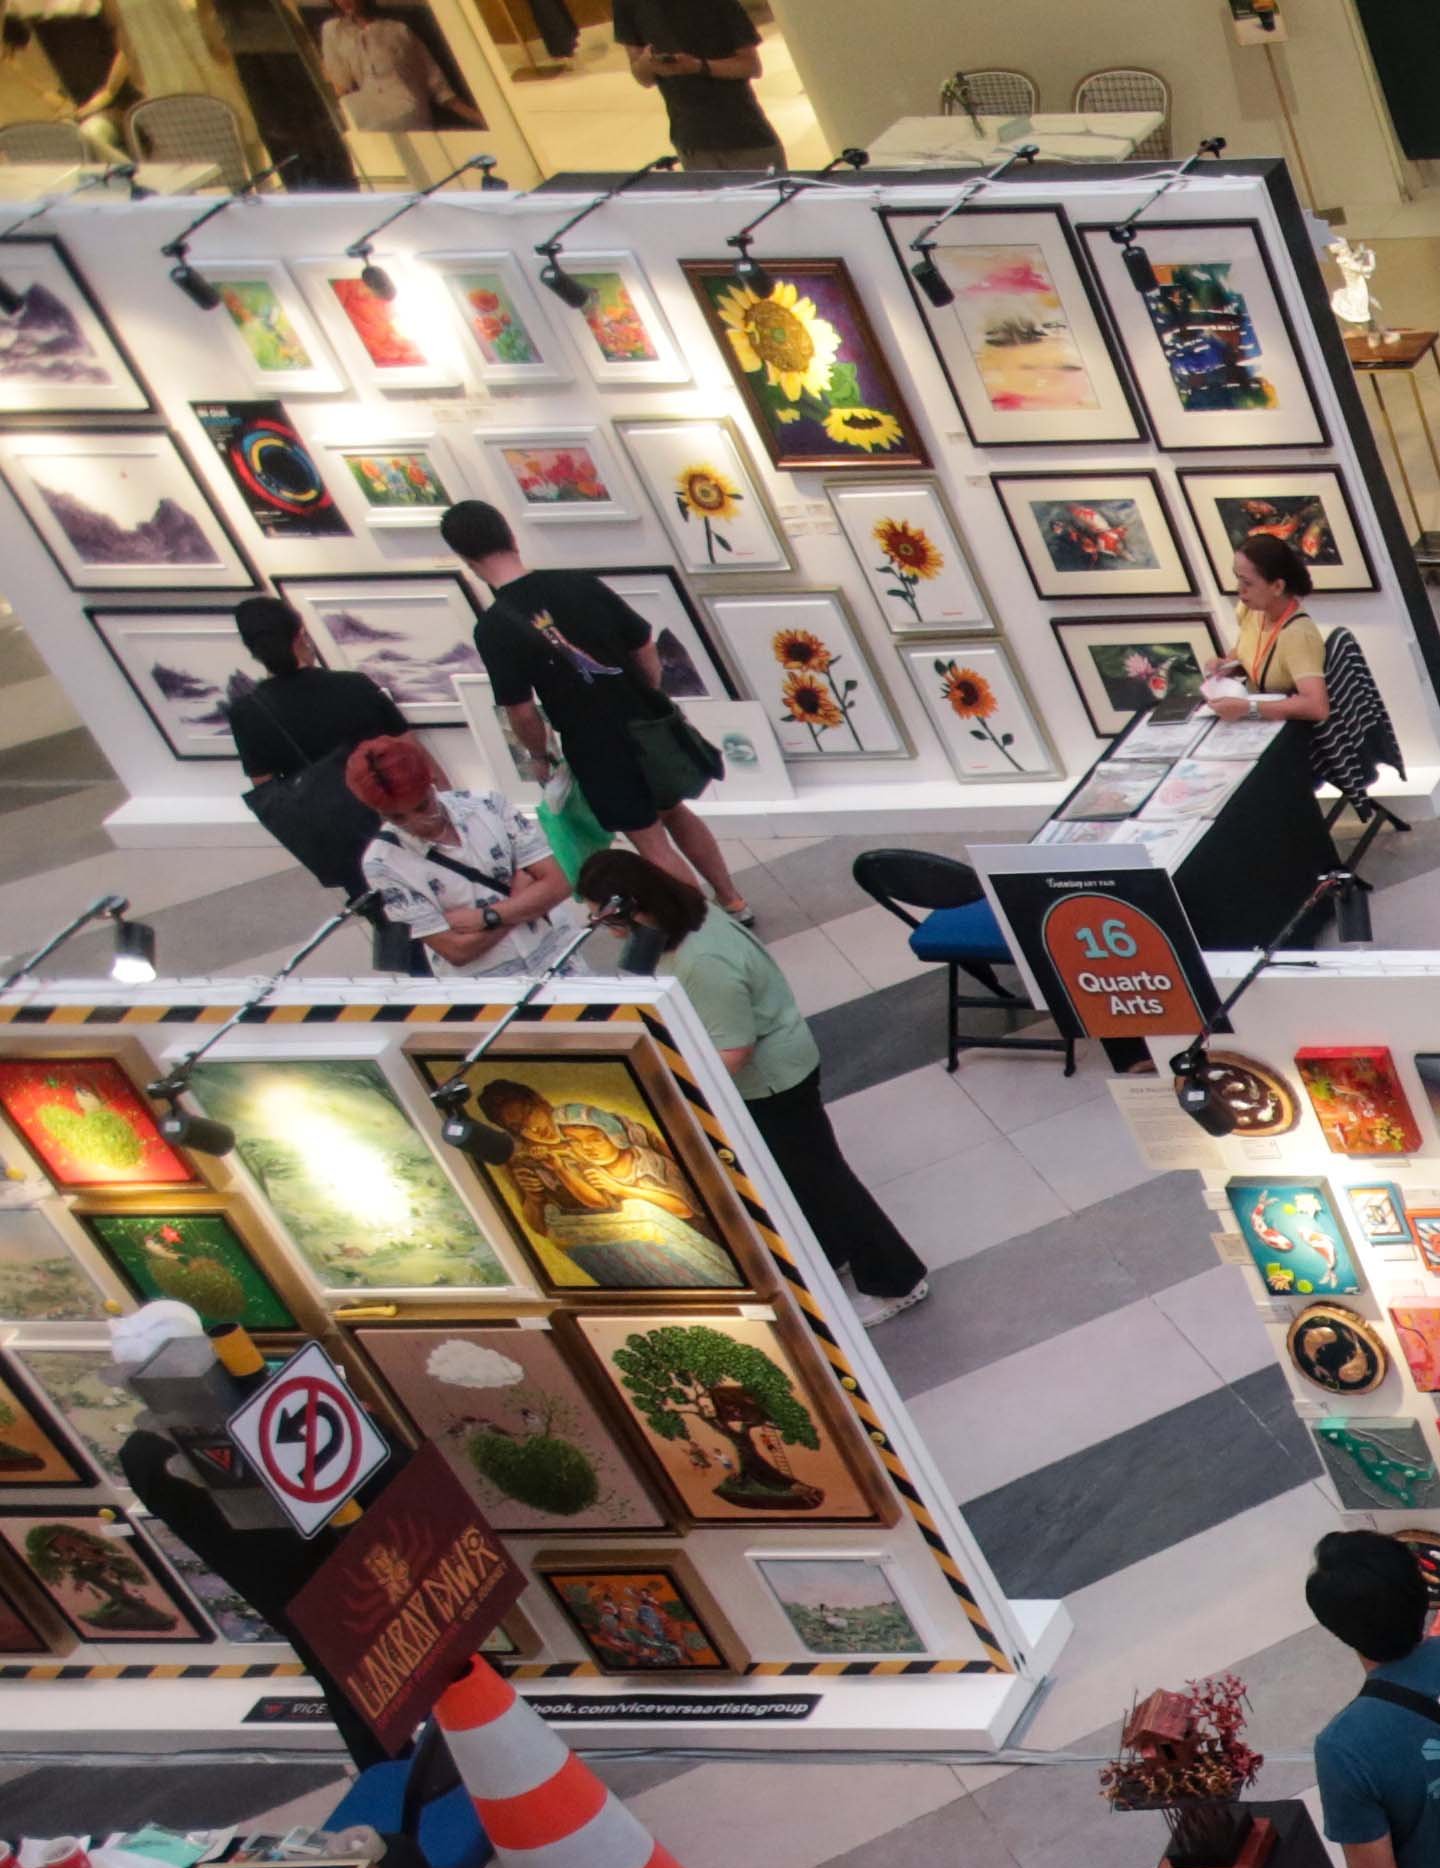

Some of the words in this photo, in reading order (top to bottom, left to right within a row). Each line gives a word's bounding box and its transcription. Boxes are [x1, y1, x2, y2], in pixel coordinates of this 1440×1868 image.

[1075, 919, 1138, 959] 16
[1077, 971, 1172, 993] Quarto
[1110, 995, 1164, 1015] Arts
[291, 1702, 328, 1715] VICE
[530, 1700, 809, 1718] book.com/viceversaartistsgroup
